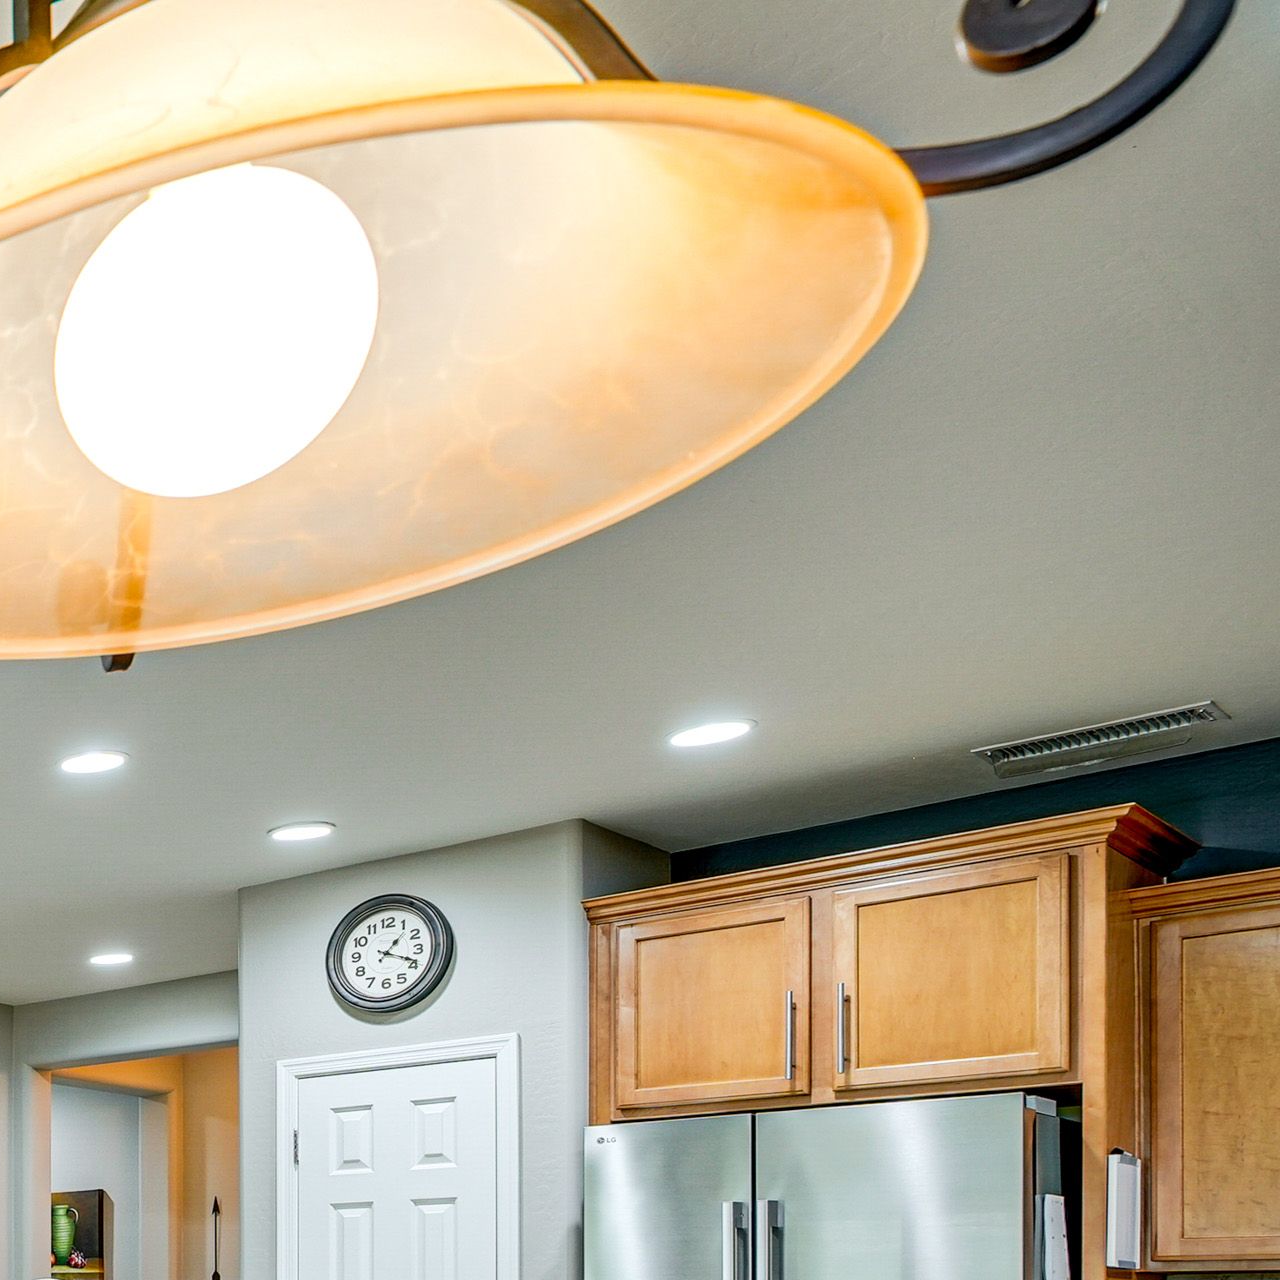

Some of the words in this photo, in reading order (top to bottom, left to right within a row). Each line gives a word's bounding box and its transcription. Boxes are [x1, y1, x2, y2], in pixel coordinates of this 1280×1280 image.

[380, 917, 396, 929] 12
[400, 919, 406, 930] 1
[366, 923, 377, 935] 11
[409, 928, 421, 940] 2
[353, 936, 368, 948] 10
[413, 943, 424, 954] 3
[351, 952, 362, 963] 9
[408, 959, 419, 970] 4
[355, 966, 366, 977] 8
[365, 977, 376, 988] 7
[381, 978, 392, 989] 6
[396, 973, 407, 984] 5
